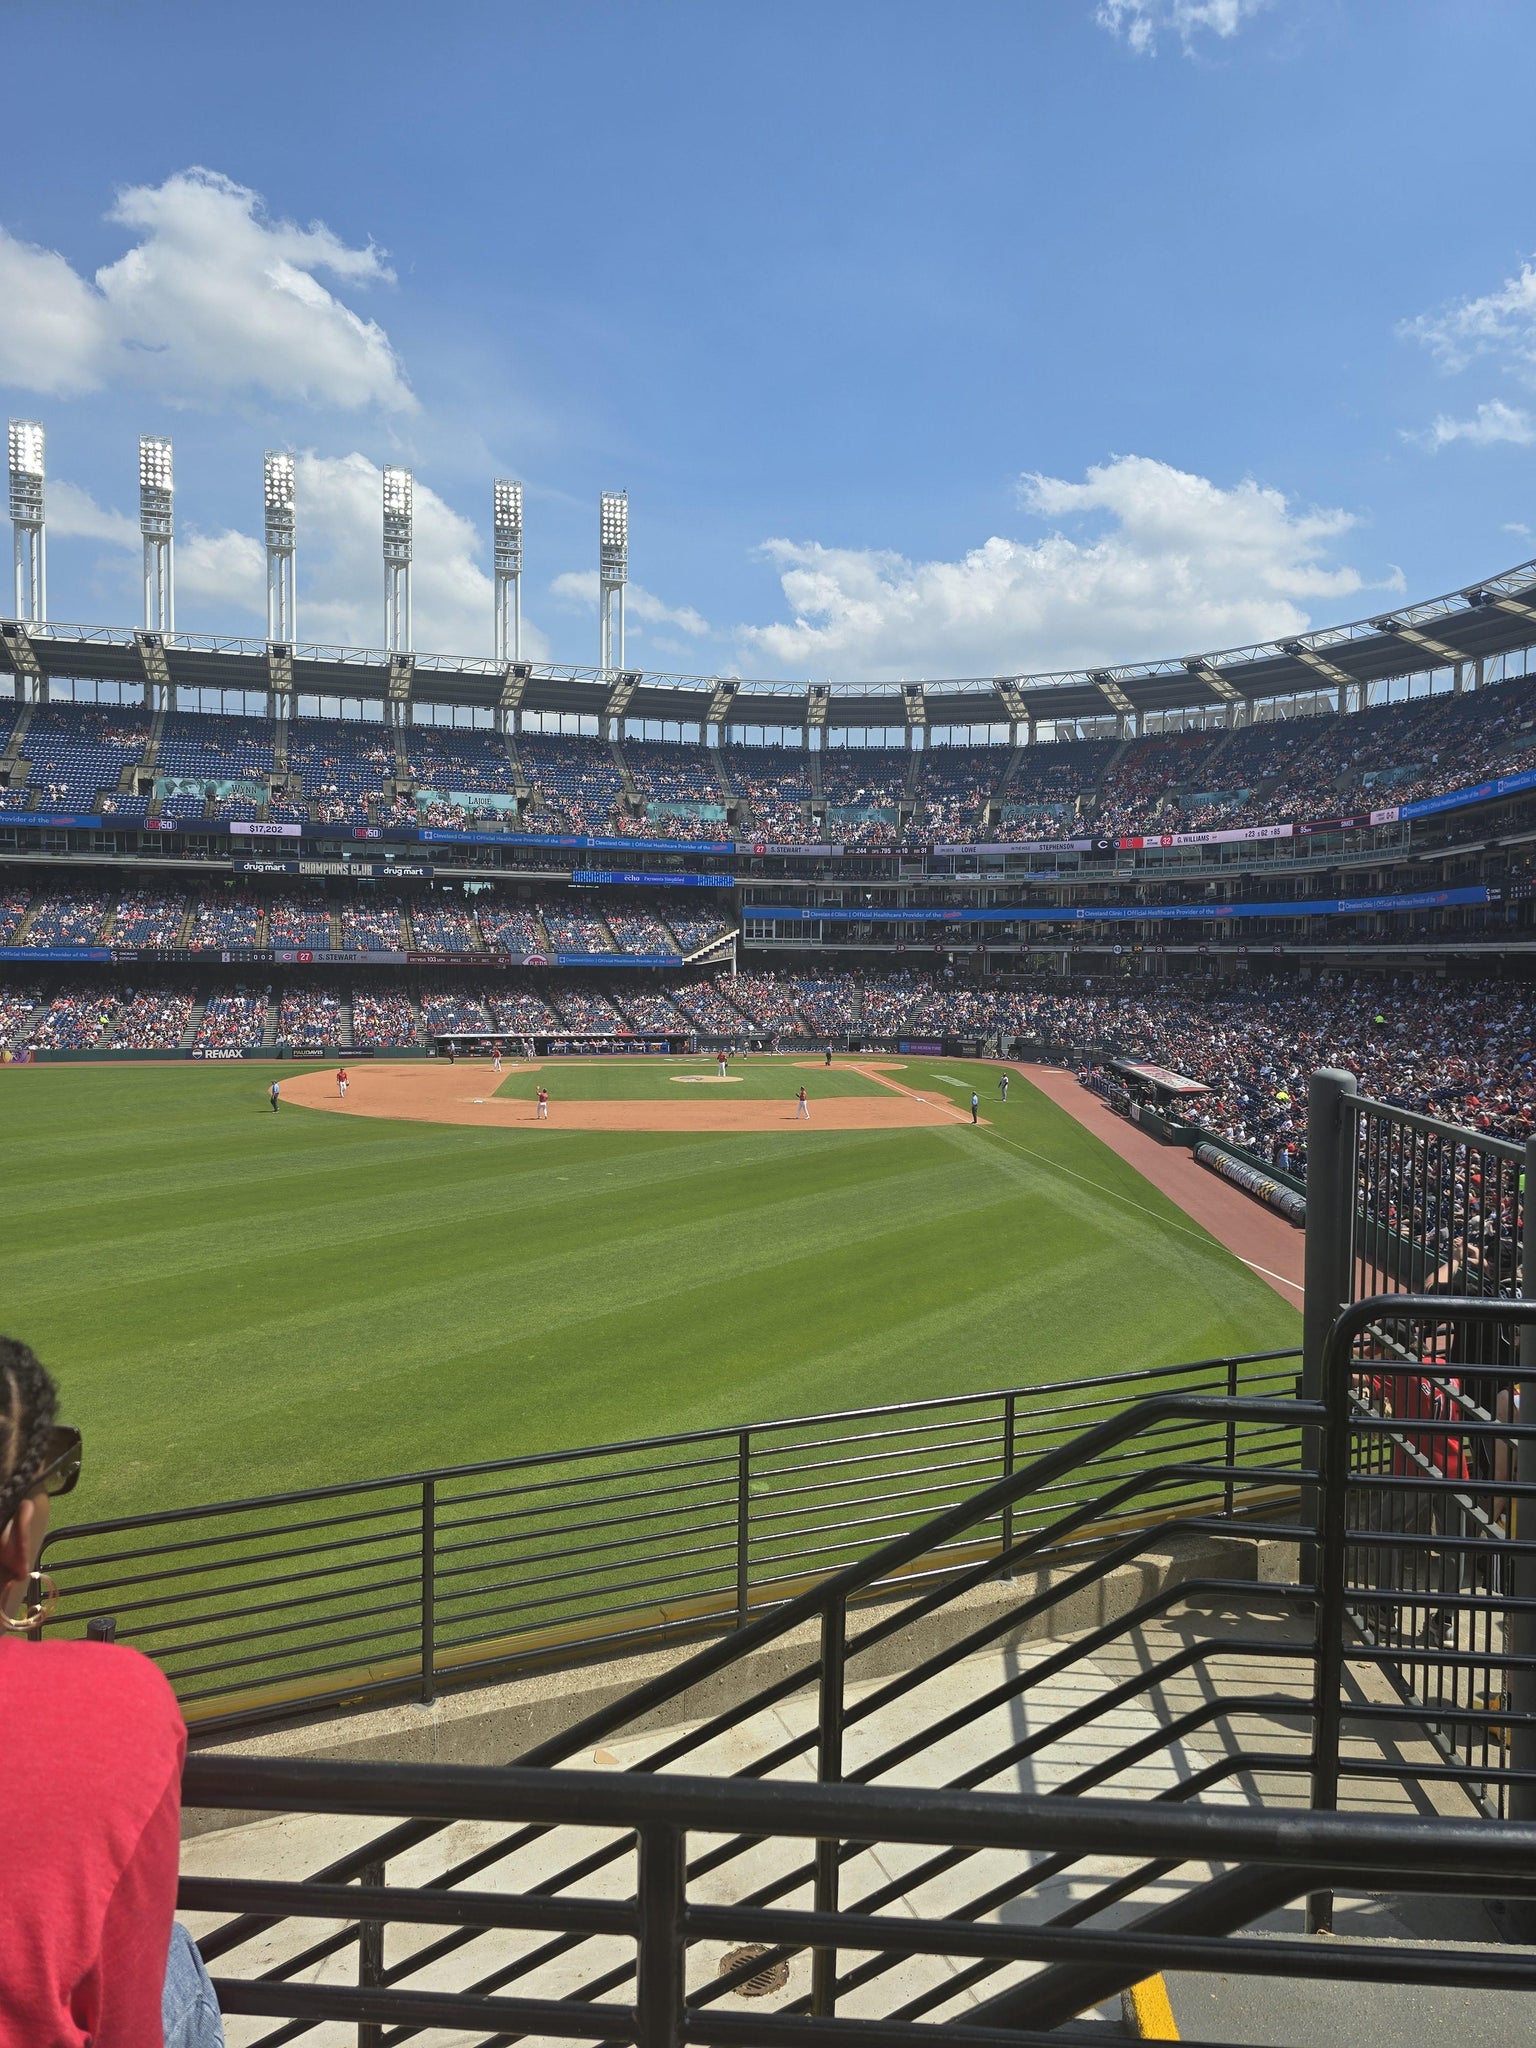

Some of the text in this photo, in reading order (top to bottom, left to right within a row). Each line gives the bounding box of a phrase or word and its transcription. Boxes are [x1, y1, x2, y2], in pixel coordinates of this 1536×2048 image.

[232, 784, 257, 794] WYNN
[468, 796, 492, 804] LAJOIE
[250, 825, 283, 833] $17,202
[244, 863, 263, 872] drug
[300, 863, 372, 875] CHAMPIONS CLUB
[384, 867, 402, 876] drug
[205, 1050, 243, 1058] REMAX
